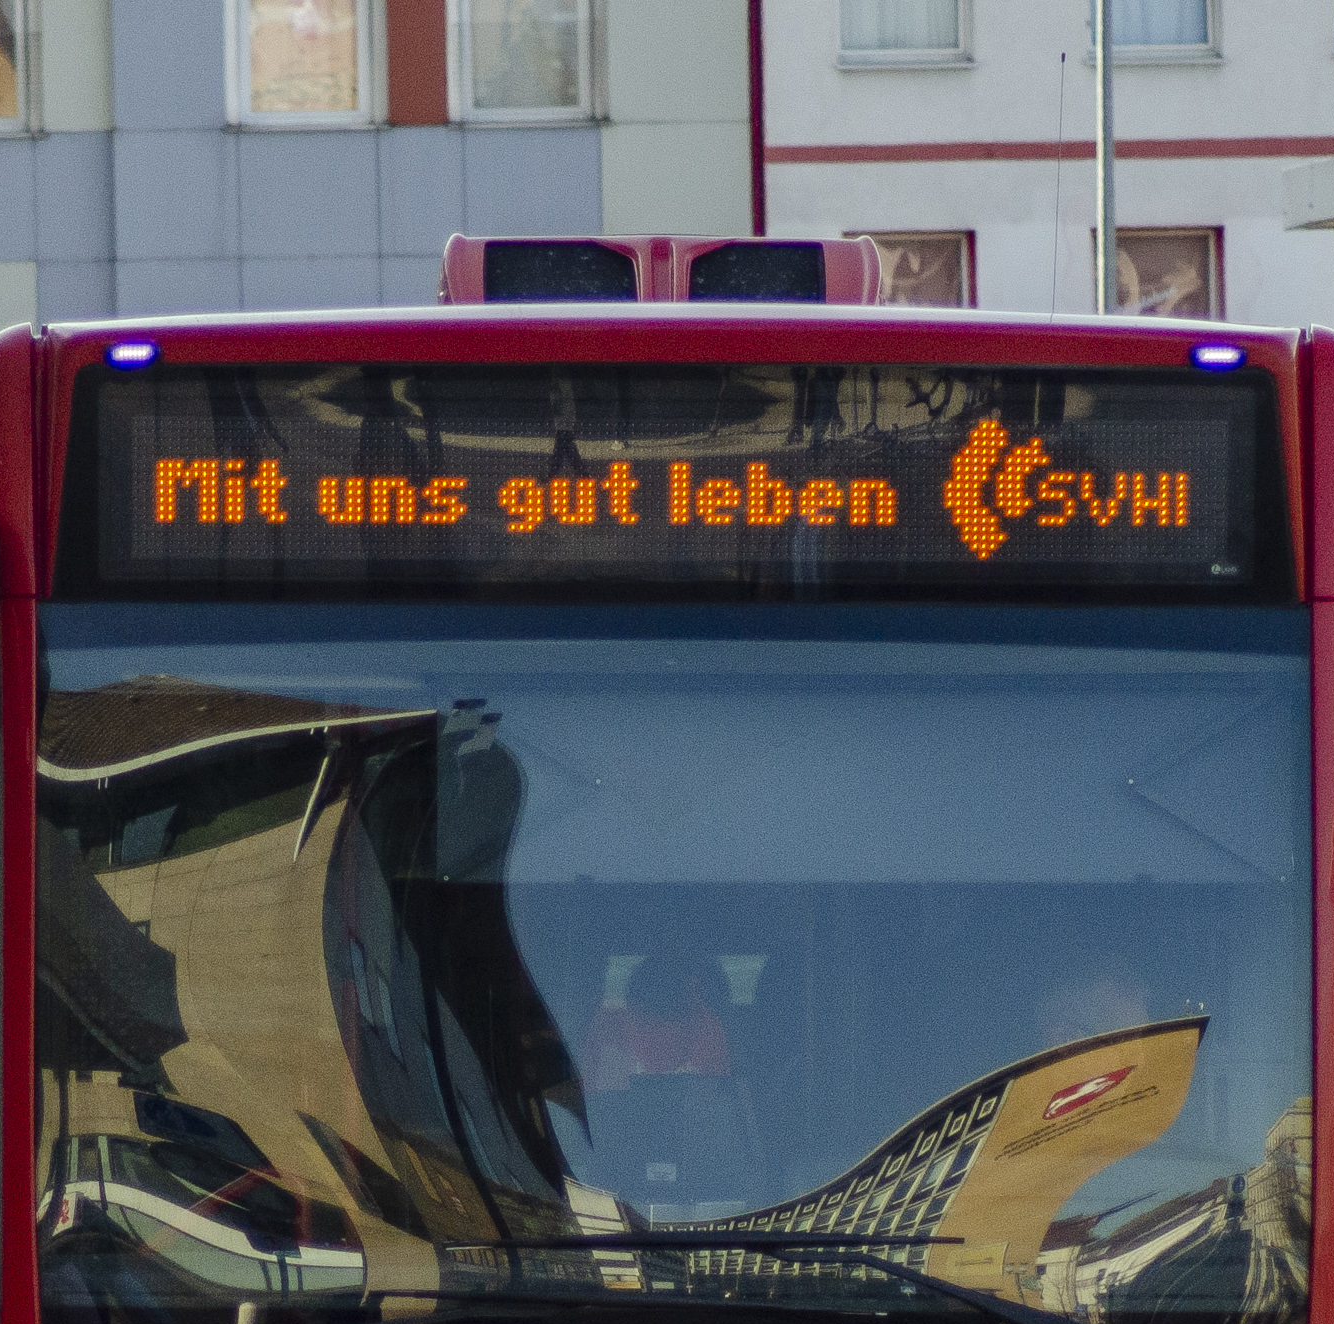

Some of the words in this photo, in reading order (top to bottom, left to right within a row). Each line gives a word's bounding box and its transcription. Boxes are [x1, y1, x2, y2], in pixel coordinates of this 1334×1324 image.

[154, 458, 288, 524] Mit
[317, 477, 468, 525] uns
[498, 460, 638, 534] gut
[668, 460, 897, 526] leben
[1036, 471, 1190, 528] SVHI
